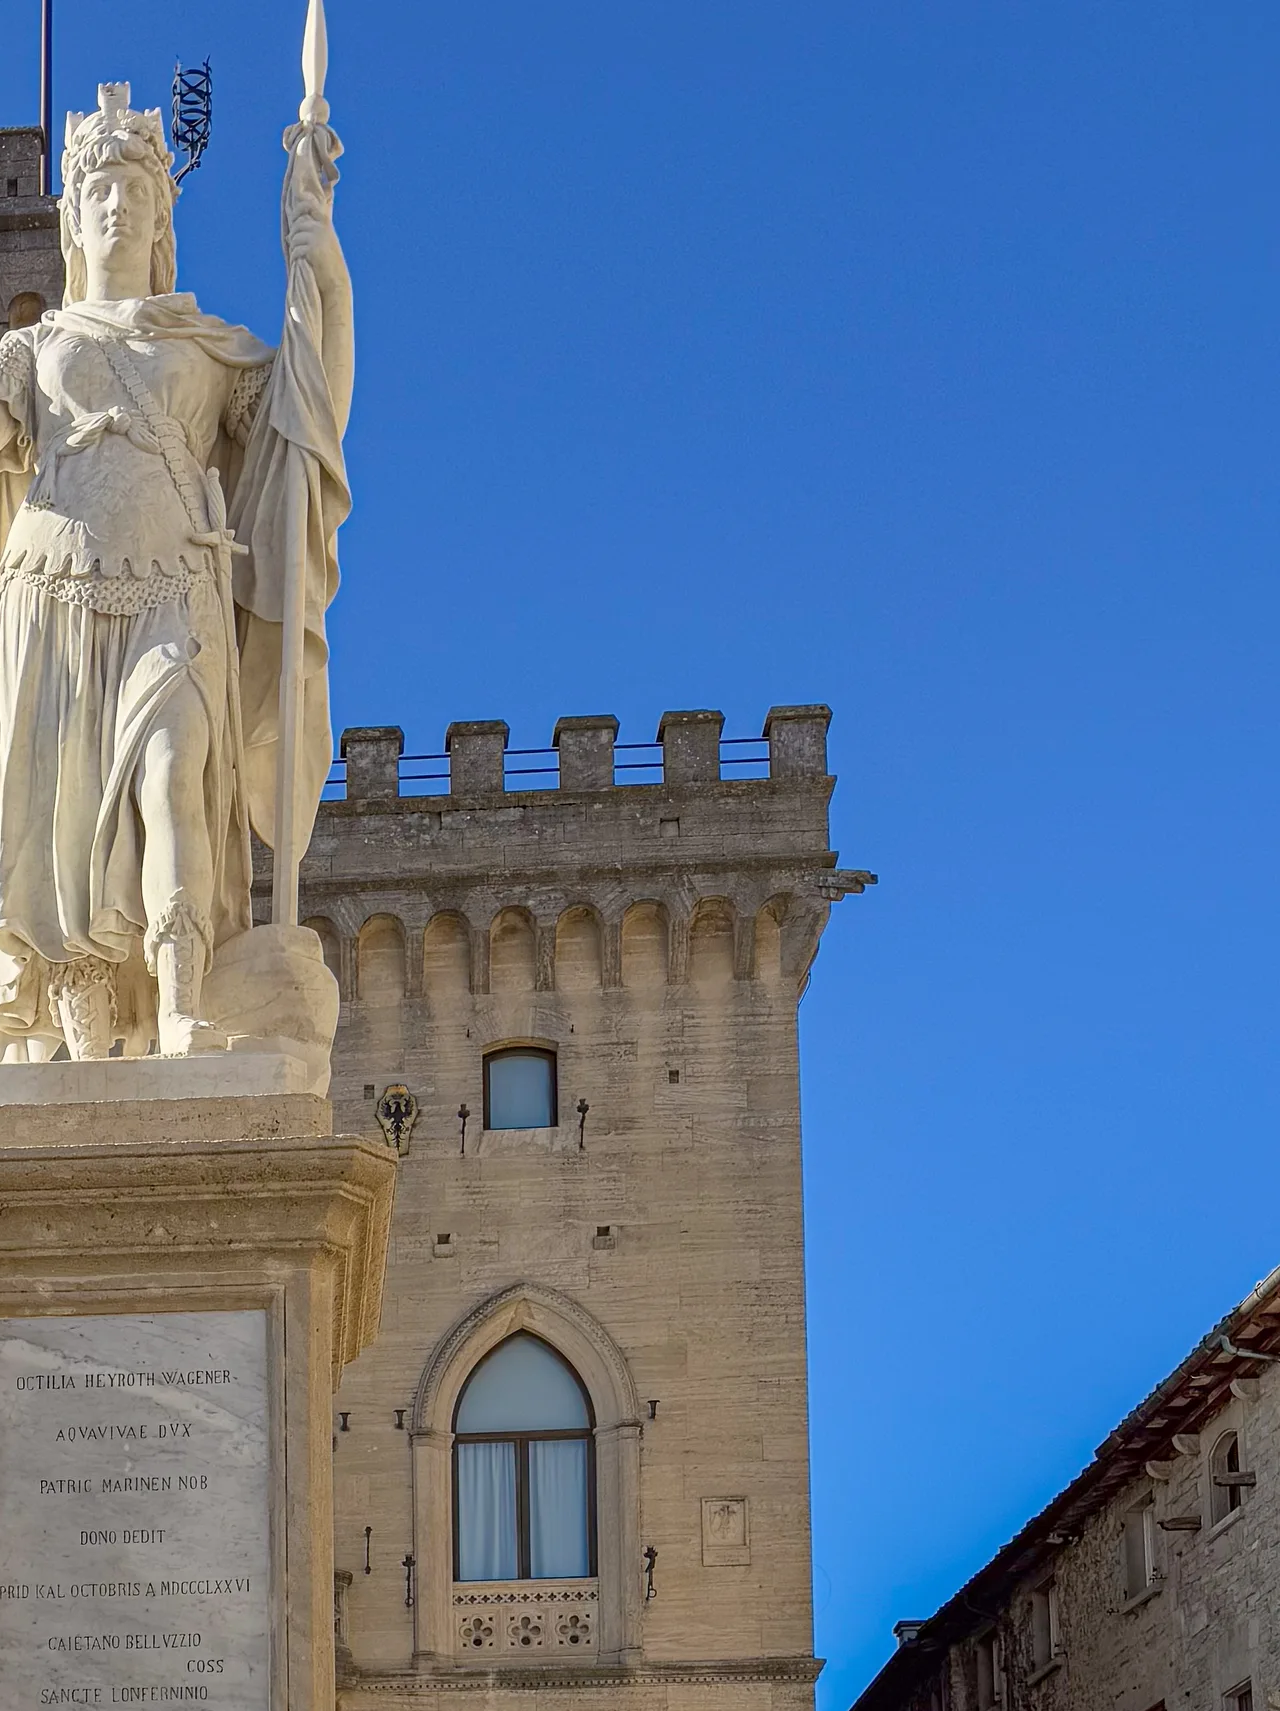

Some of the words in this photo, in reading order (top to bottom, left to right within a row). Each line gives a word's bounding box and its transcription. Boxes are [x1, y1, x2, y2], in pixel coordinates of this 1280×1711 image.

[16, 1374, 76, 1391] OCTILIA
[85, 1372, 155, 1388] HEYROTH
[161, 1369, 231, 1386] WAGENER
[55, 1424, 147, 1443] AQVAVIVAE
[158, 1423, 193, 1439] DVX
[40, 1479, 92, 1495] PATRIC
[102, 1476, 171, 1493] MARINEN
[178, 1475, 208, 1491] NOB
[80, 1530, 117, 1546] DONO
[123, 1529, 166, 1544] DEDIT
[0, 1584, 30, 1600] PRID
[35, 1584, 66, 1599] KAL
[70, 1582, 141, 1598] OCTOBRIS
[145, 1582, 156, 1597] A
[160, 1578, 251, 1596] MDCCCLXXVI
[48, 1634, 121, 1651] CAIETANO
[186, 1659, 224, 1674] COSS
[40, 1688, 102, 1705] SANCTE
